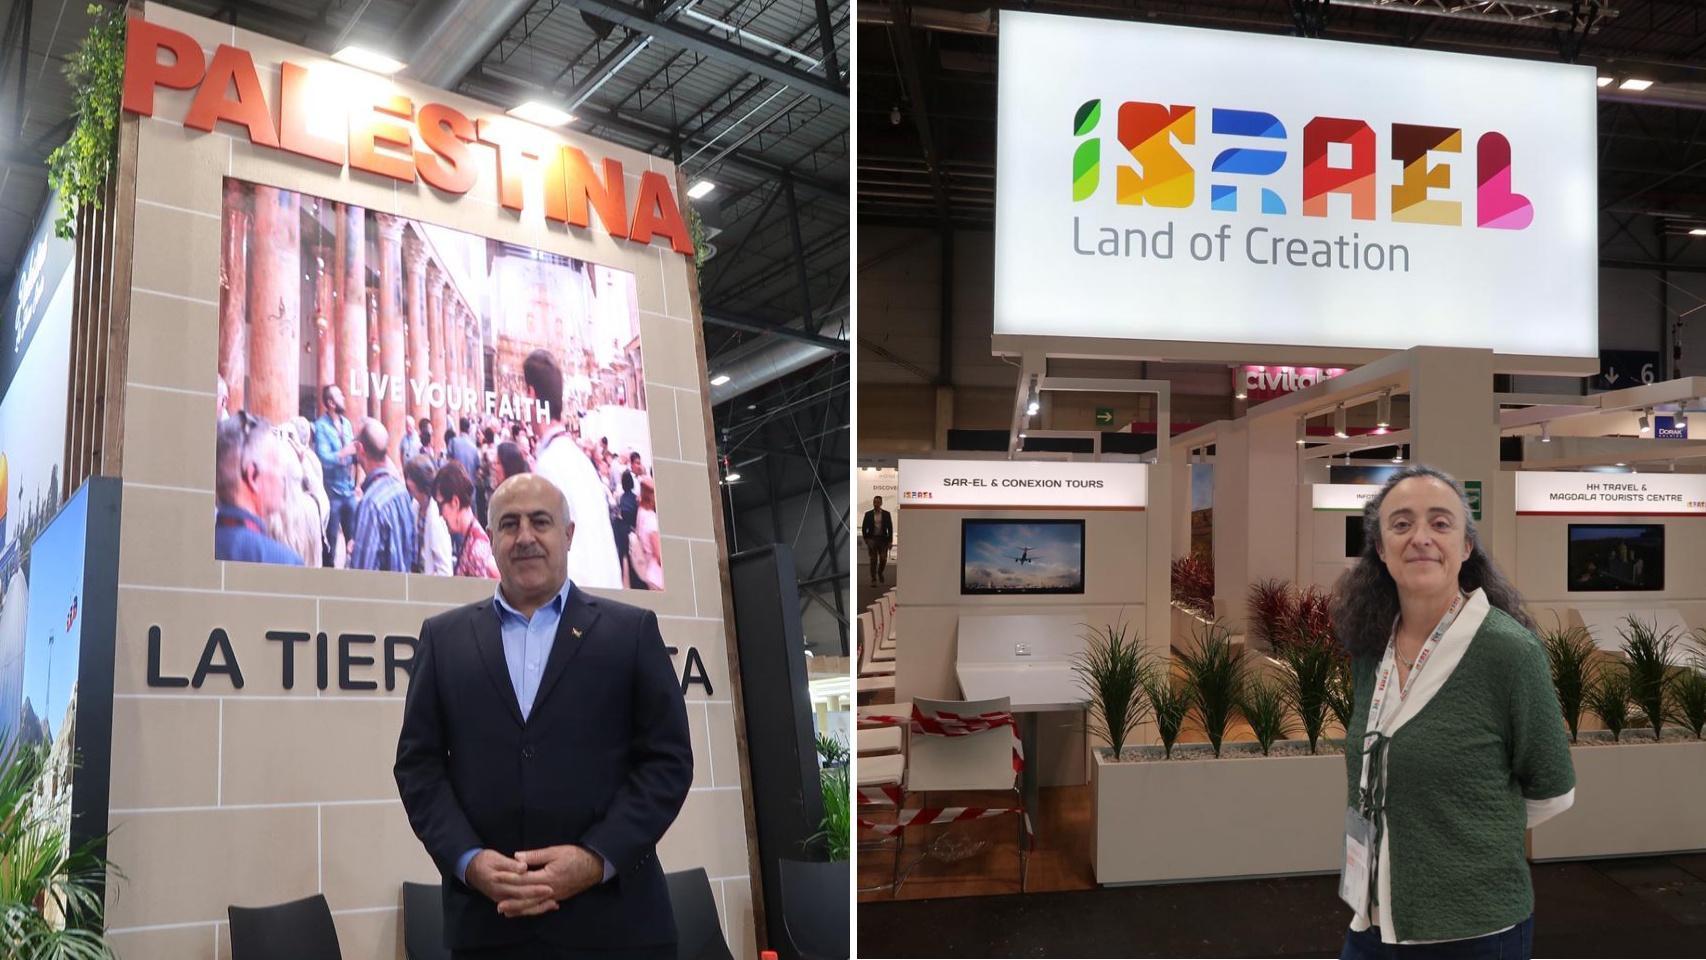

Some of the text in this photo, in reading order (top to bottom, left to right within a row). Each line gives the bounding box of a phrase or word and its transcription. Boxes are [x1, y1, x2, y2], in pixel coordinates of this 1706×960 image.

[122, 17, 695, 256] PALESTINA
[1073, 216, 1410, 272] Land of Creation
[1641, 363, 1655, 385] 6
[350, 368, 551, 425] LIVE YOUR FAITH
[943, 478, 1104, 488] SAR-EL & CONEXION TOURS
[1549, 493, 1683, 502] MAGDALA TOURISTS CENTRE
[1586, 483, 1600, 491] HH
[147, 625, 244, 689] LA
[265, 630, 419, 691] TIER
